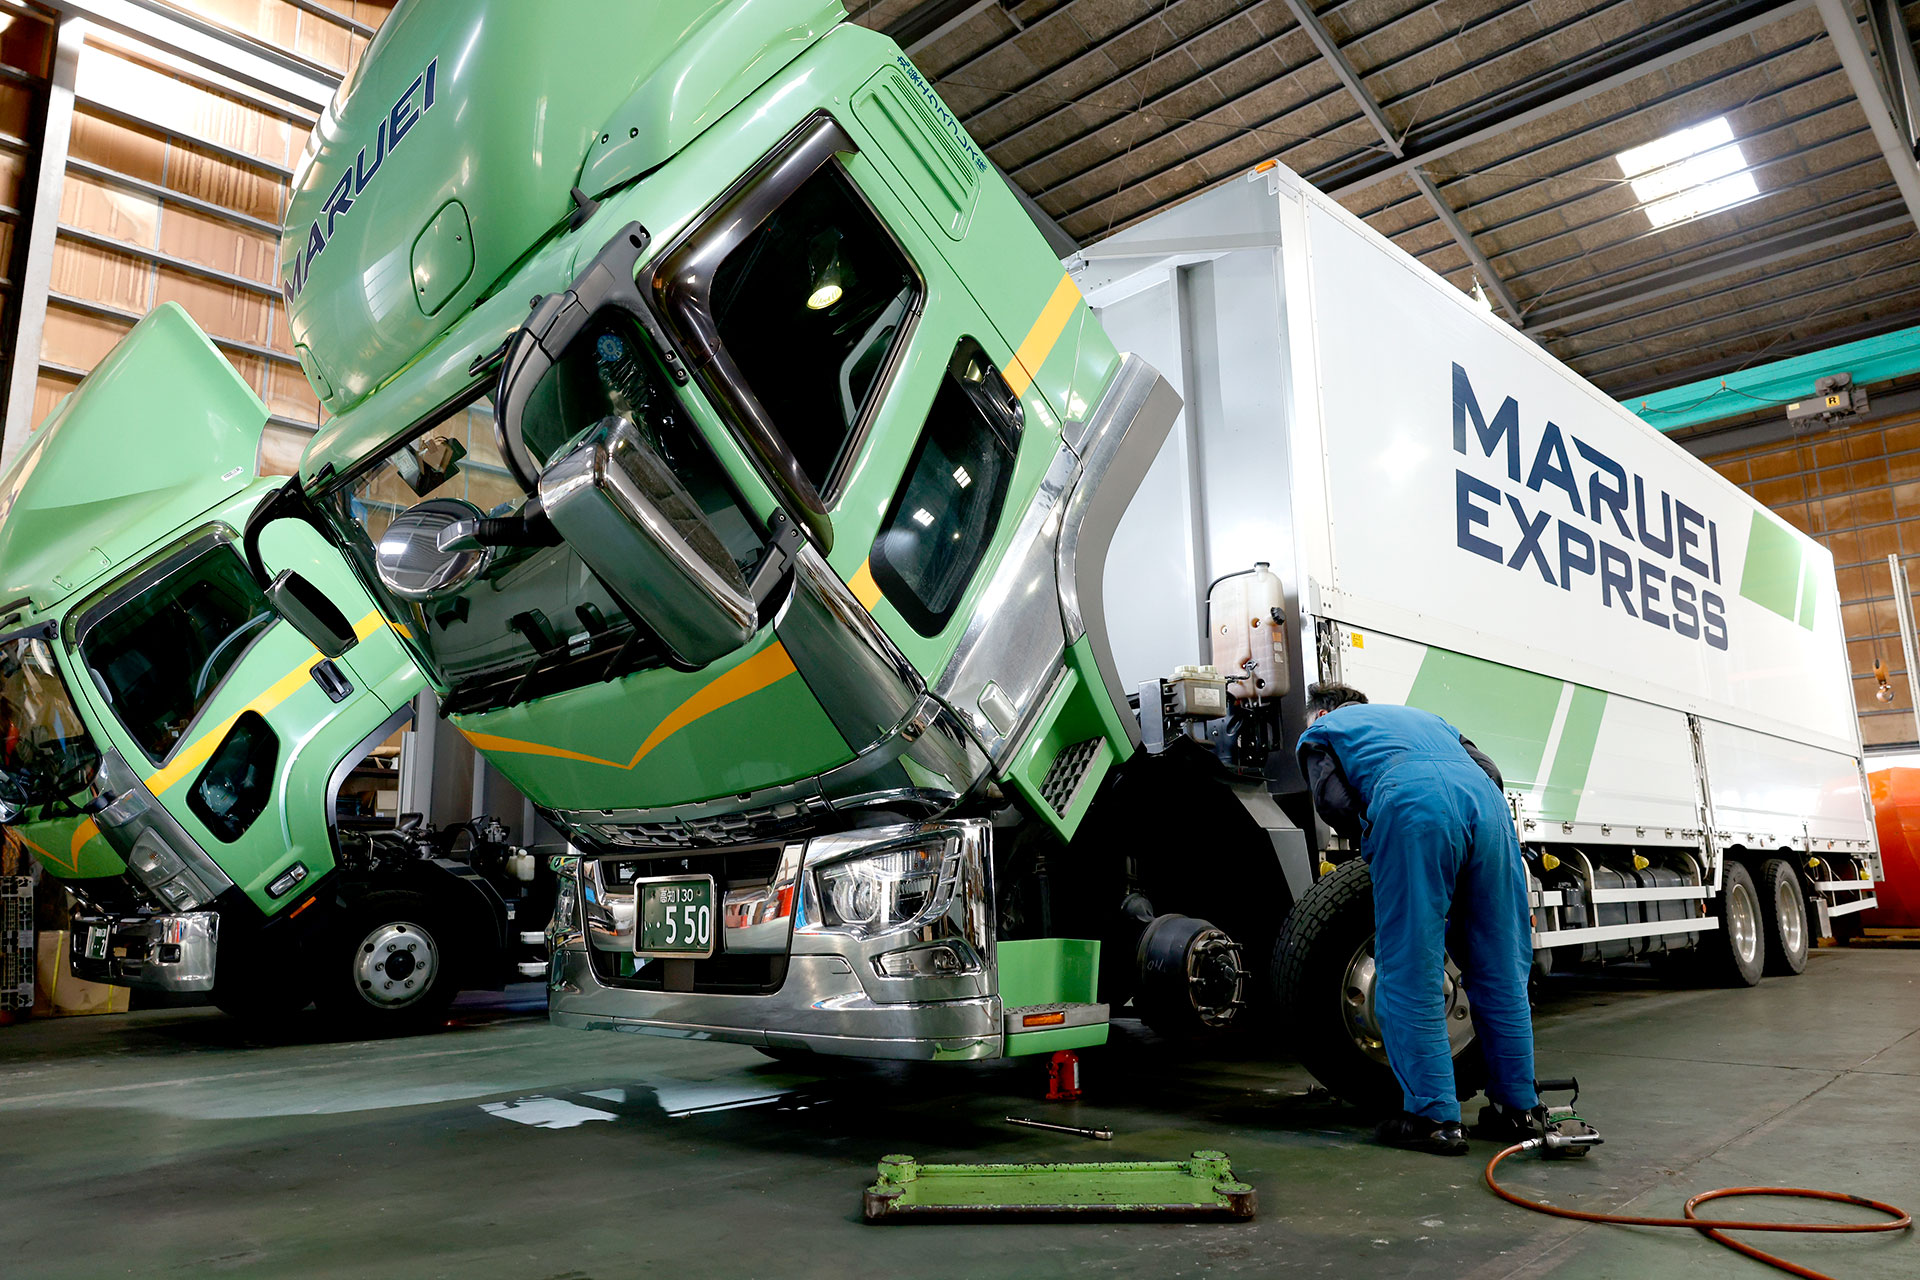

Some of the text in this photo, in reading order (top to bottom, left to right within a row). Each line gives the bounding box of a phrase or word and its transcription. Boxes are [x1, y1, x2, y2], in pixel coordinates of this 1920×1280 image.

[284, 56, 438, 321] MARUEI
[1452, 361, 1721, 586] MARUEI
[1828, 396, 1837, 405] R
[1456, 468, 1729, 652] EXPRESS
